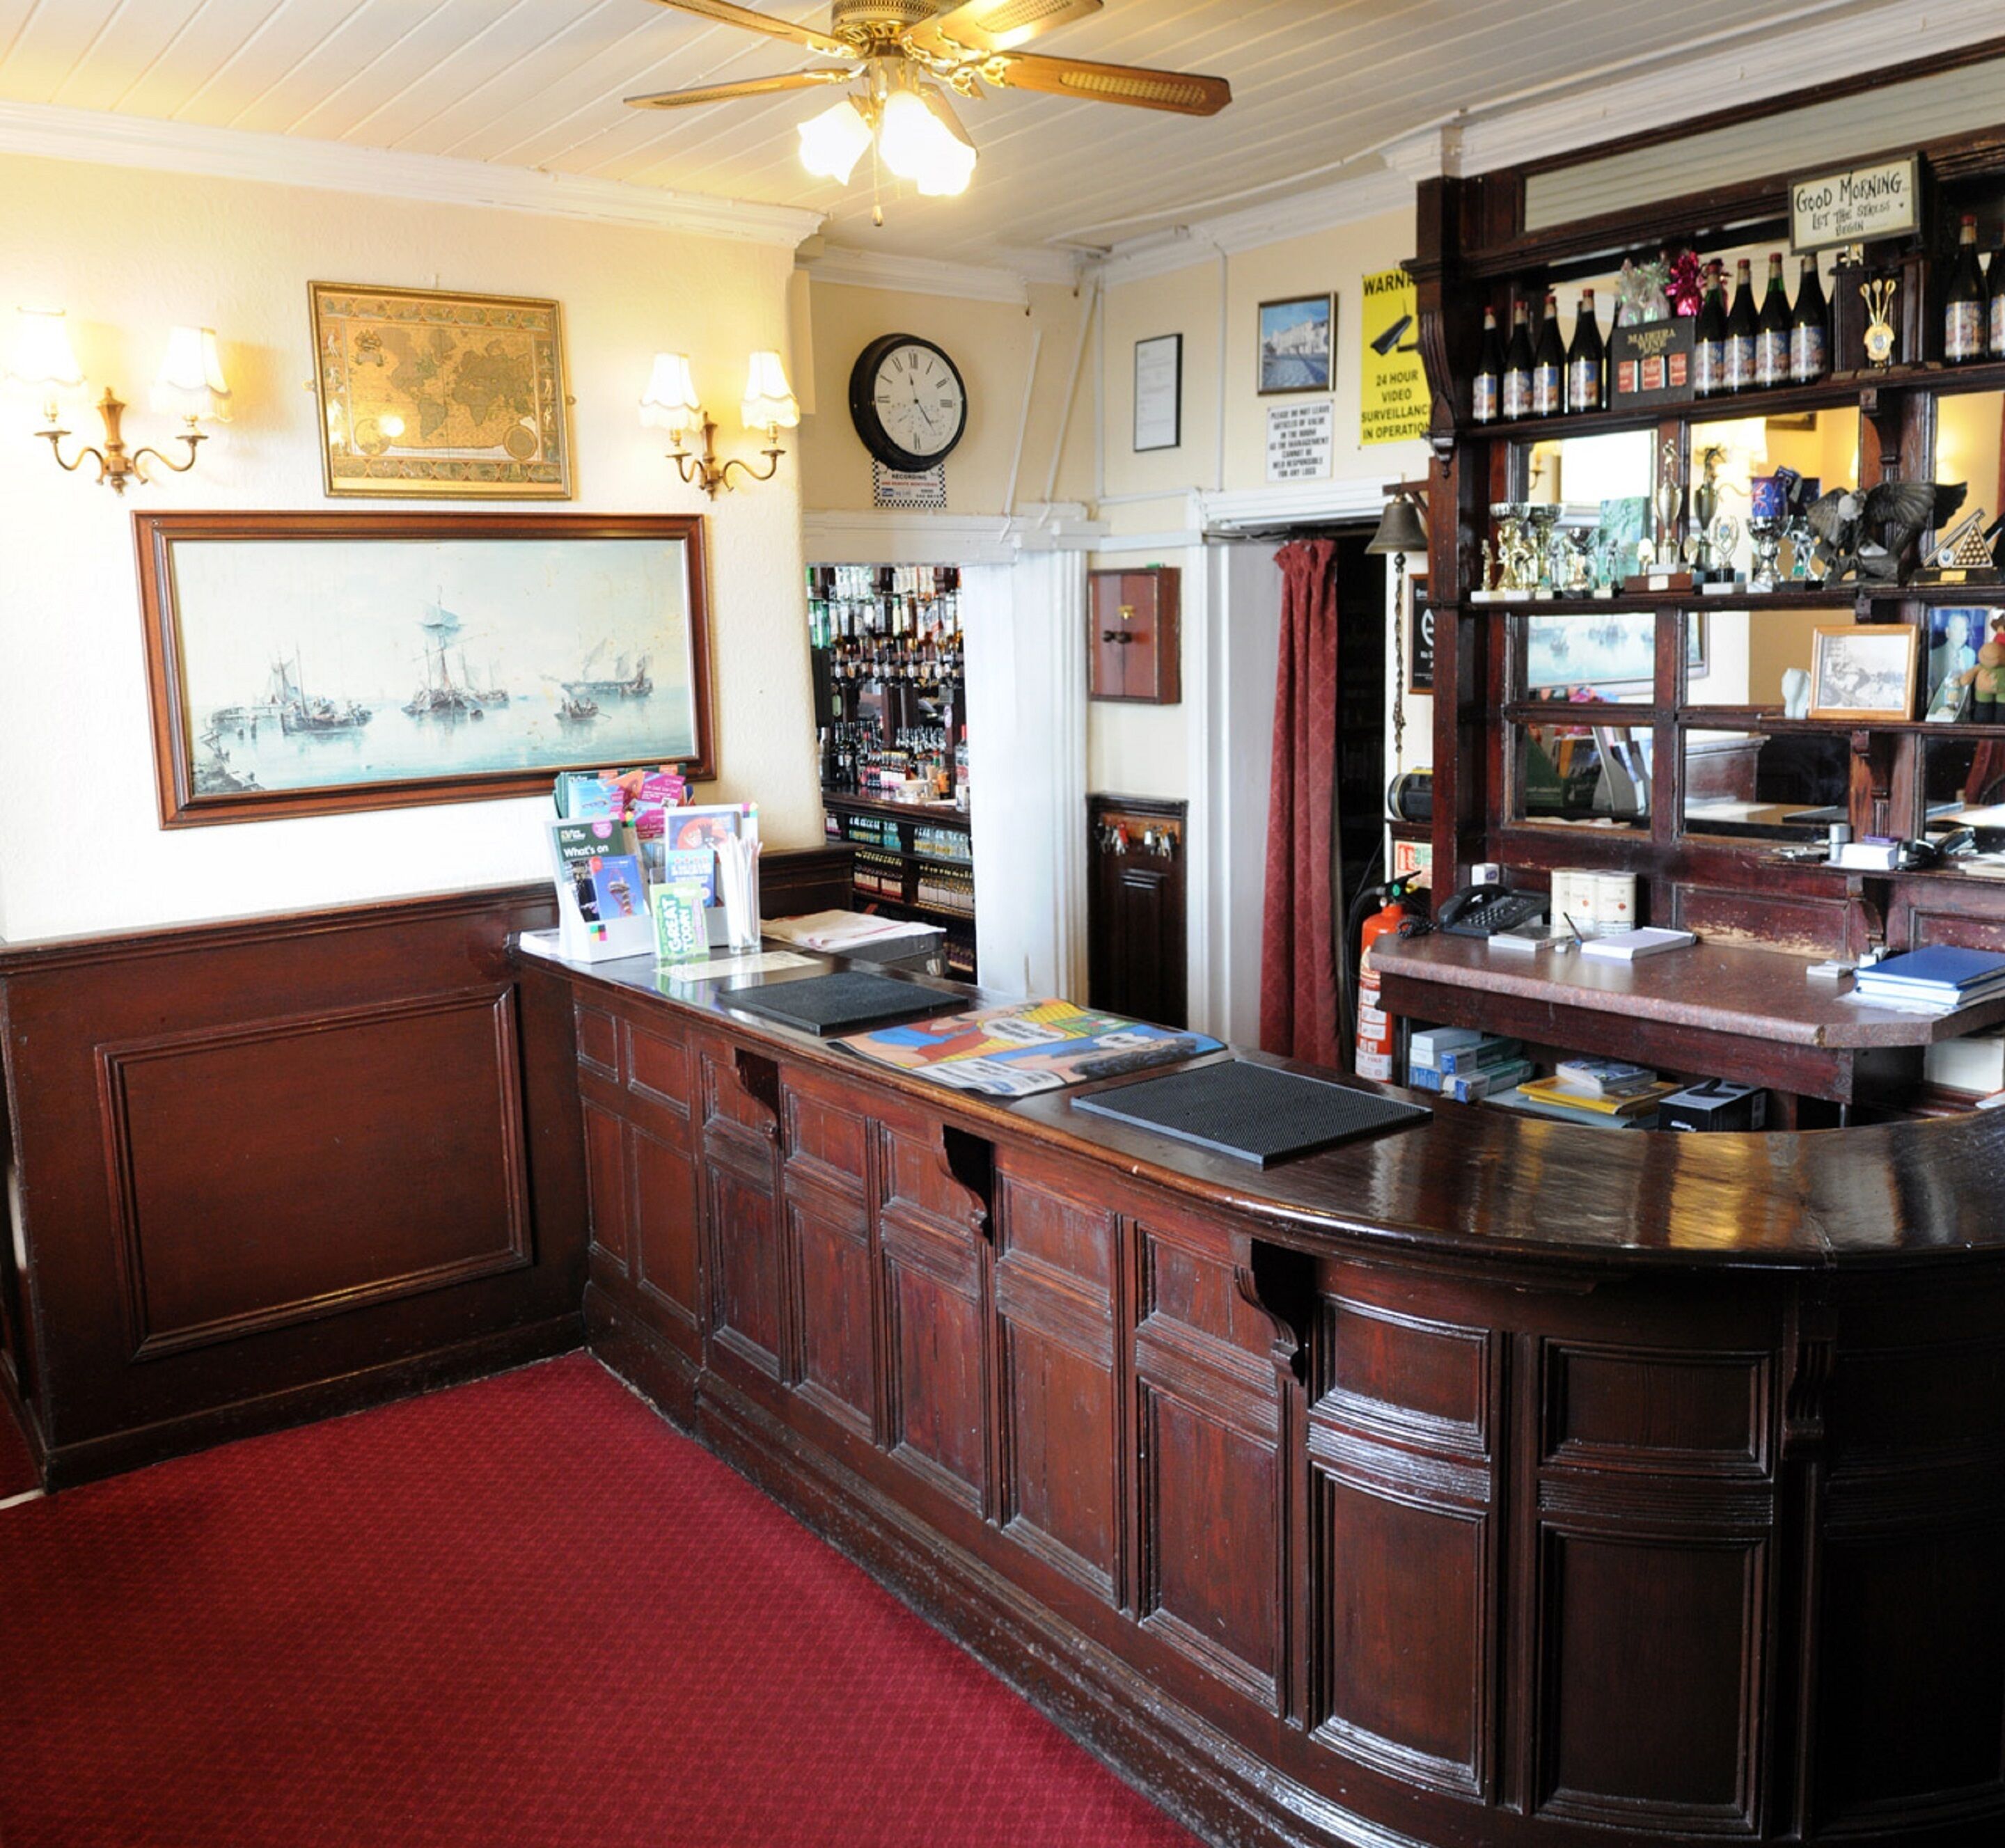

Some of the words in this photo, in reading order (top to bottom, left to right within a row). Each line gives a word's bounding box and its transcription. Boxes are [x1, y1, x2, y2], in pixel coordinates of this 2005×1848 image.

[1811, 212, 1831, 230] LET
[1832, 207, 1853, 225] THE
[1376, 374, 1387, 387] 24
[1389, 369, 1418, 385] HOUR
[1381, 388, 1412, 402] VIDEO
[1362, 404, 1428, 423] SURVEILLANC
[1362, 427, 1374, 440] IN
[563, 845, 595, 858] What's
[597, 844, 610, 854] on
[663, 898, 682, 951] GREAT
